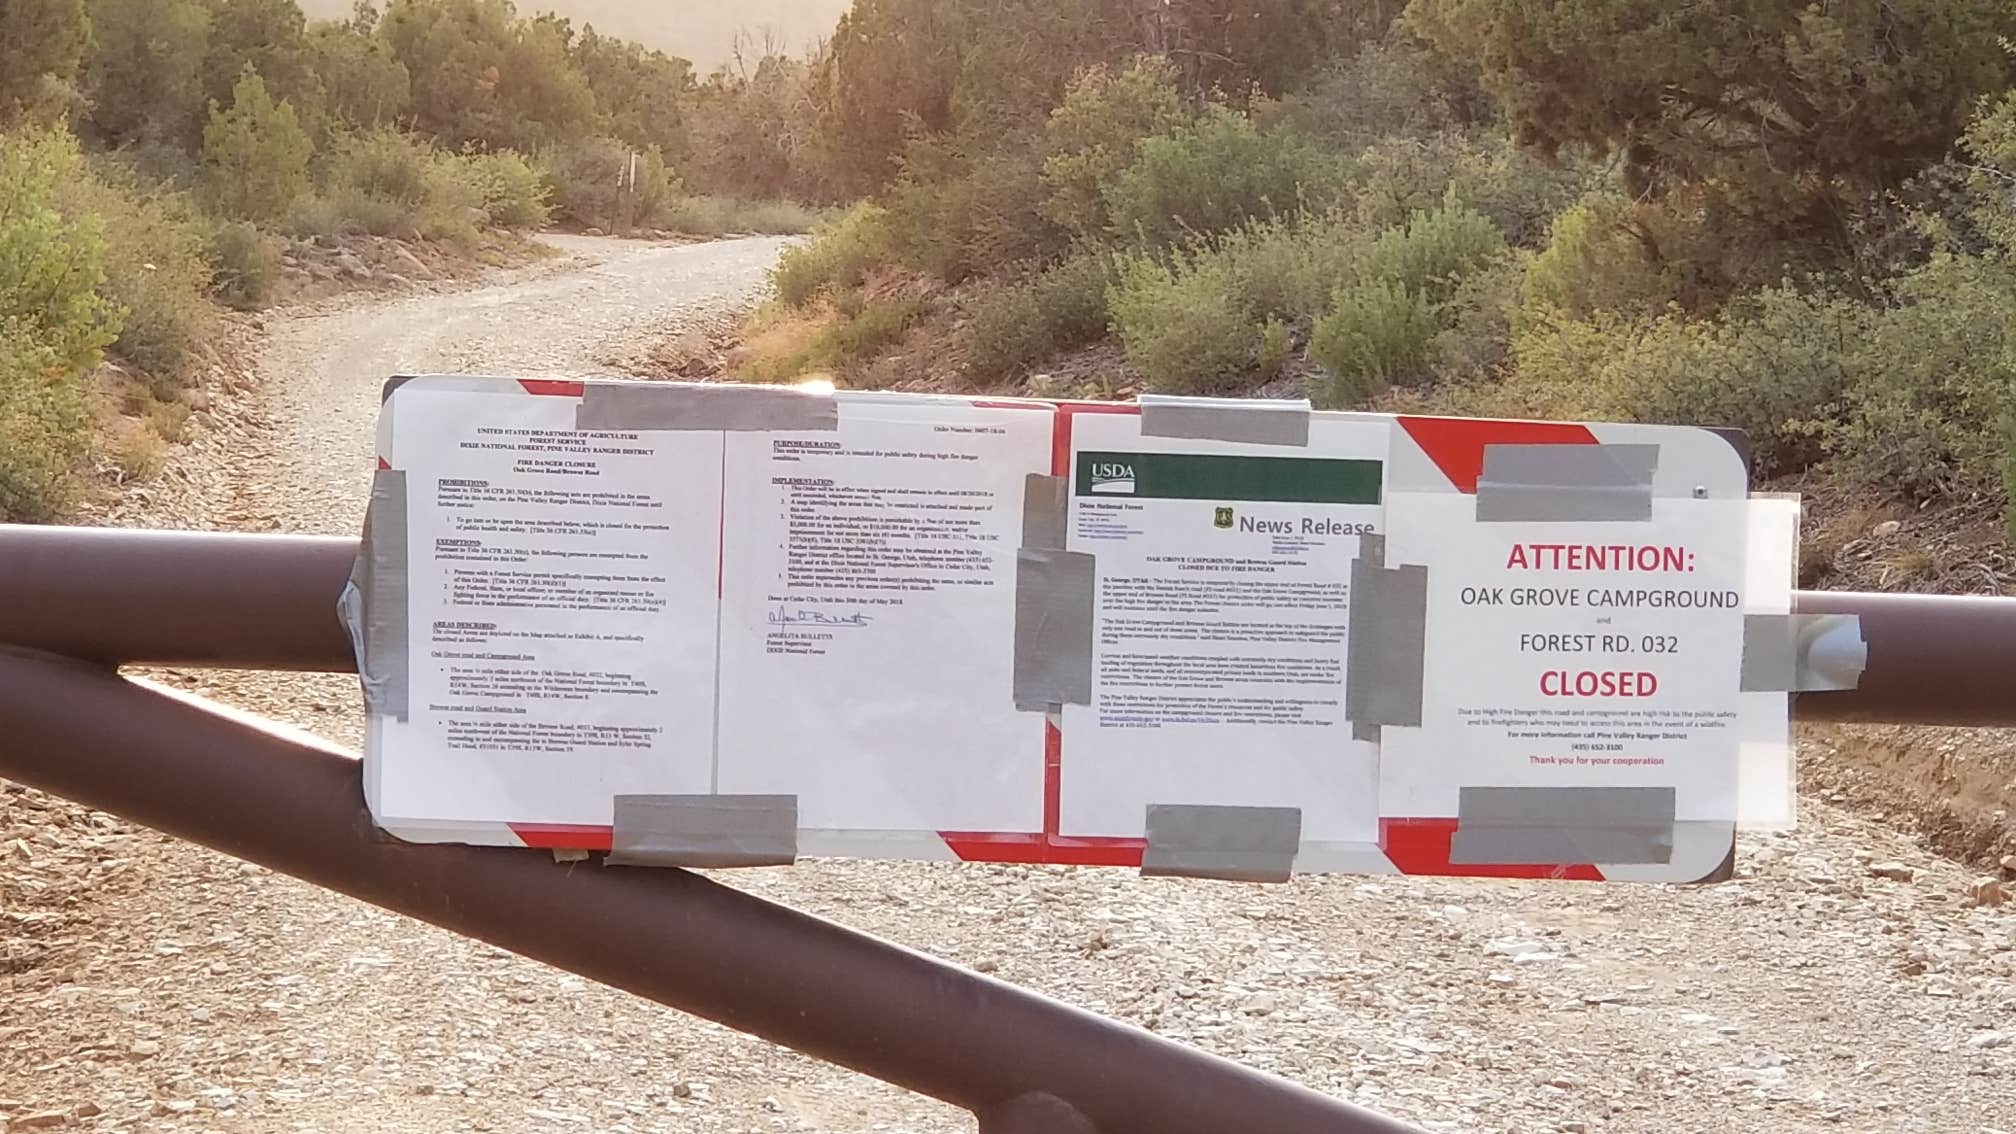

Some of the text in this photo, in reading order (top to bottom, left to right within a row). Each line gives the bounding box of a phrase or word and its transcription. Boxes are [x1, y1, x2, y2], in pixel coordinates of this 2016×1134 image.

[477, 427, 503, 435] UNITED
[504, 428, 529, 436] STATES
[530, 429, 577, 437] DEPARTMENT
[589, 431, 638, 440] AGRICULTURE
[529, 437, 586, 446] FOREST SERVICE
[459, 441, 653, 456] DIXIE NATIONAL FOREST, PINE VALLEY RANGER DISTRICT
[516, 458, 596, 469] FIRE DANGER CLOSURE
[1092, 463, 1135, 478] USDA
[1240, 516, 1375, 536] News Release
[1507, 544, 1694, 572] ATTENTION:
[1177, 563, 1204, 571] CLOSED
[1205, 564, 1219, 572] DUE
[1230, 565, 1246, 573] FIRE
[1247, 565, 1275, 573] DANGER
[1461, 587, 1739, 608] OAK GROVE CAMPGROUND
[1596, 617, 1611, 625] and
[1520, 634, 1678, 653] FOREST RD. 032
[1540, 671, 1657, 697] CLOSED
[1538, 708, 1553, 716] this
[1571, 709, 1584, 717] and
[1612, 719, 1625, 727] this
[1540, 731, 1581, 739] information
[1596, 731, 1611, 739] Pine
[1613, 731, 1634, 739] Valley
[1635, 732, 1660, 740] Ranger
[1661, 732, 1687, 740] District
[1590, 743, 1623, 751] 652-3100
[1529, 756, 1664, 766] Thank you for your cooperation
